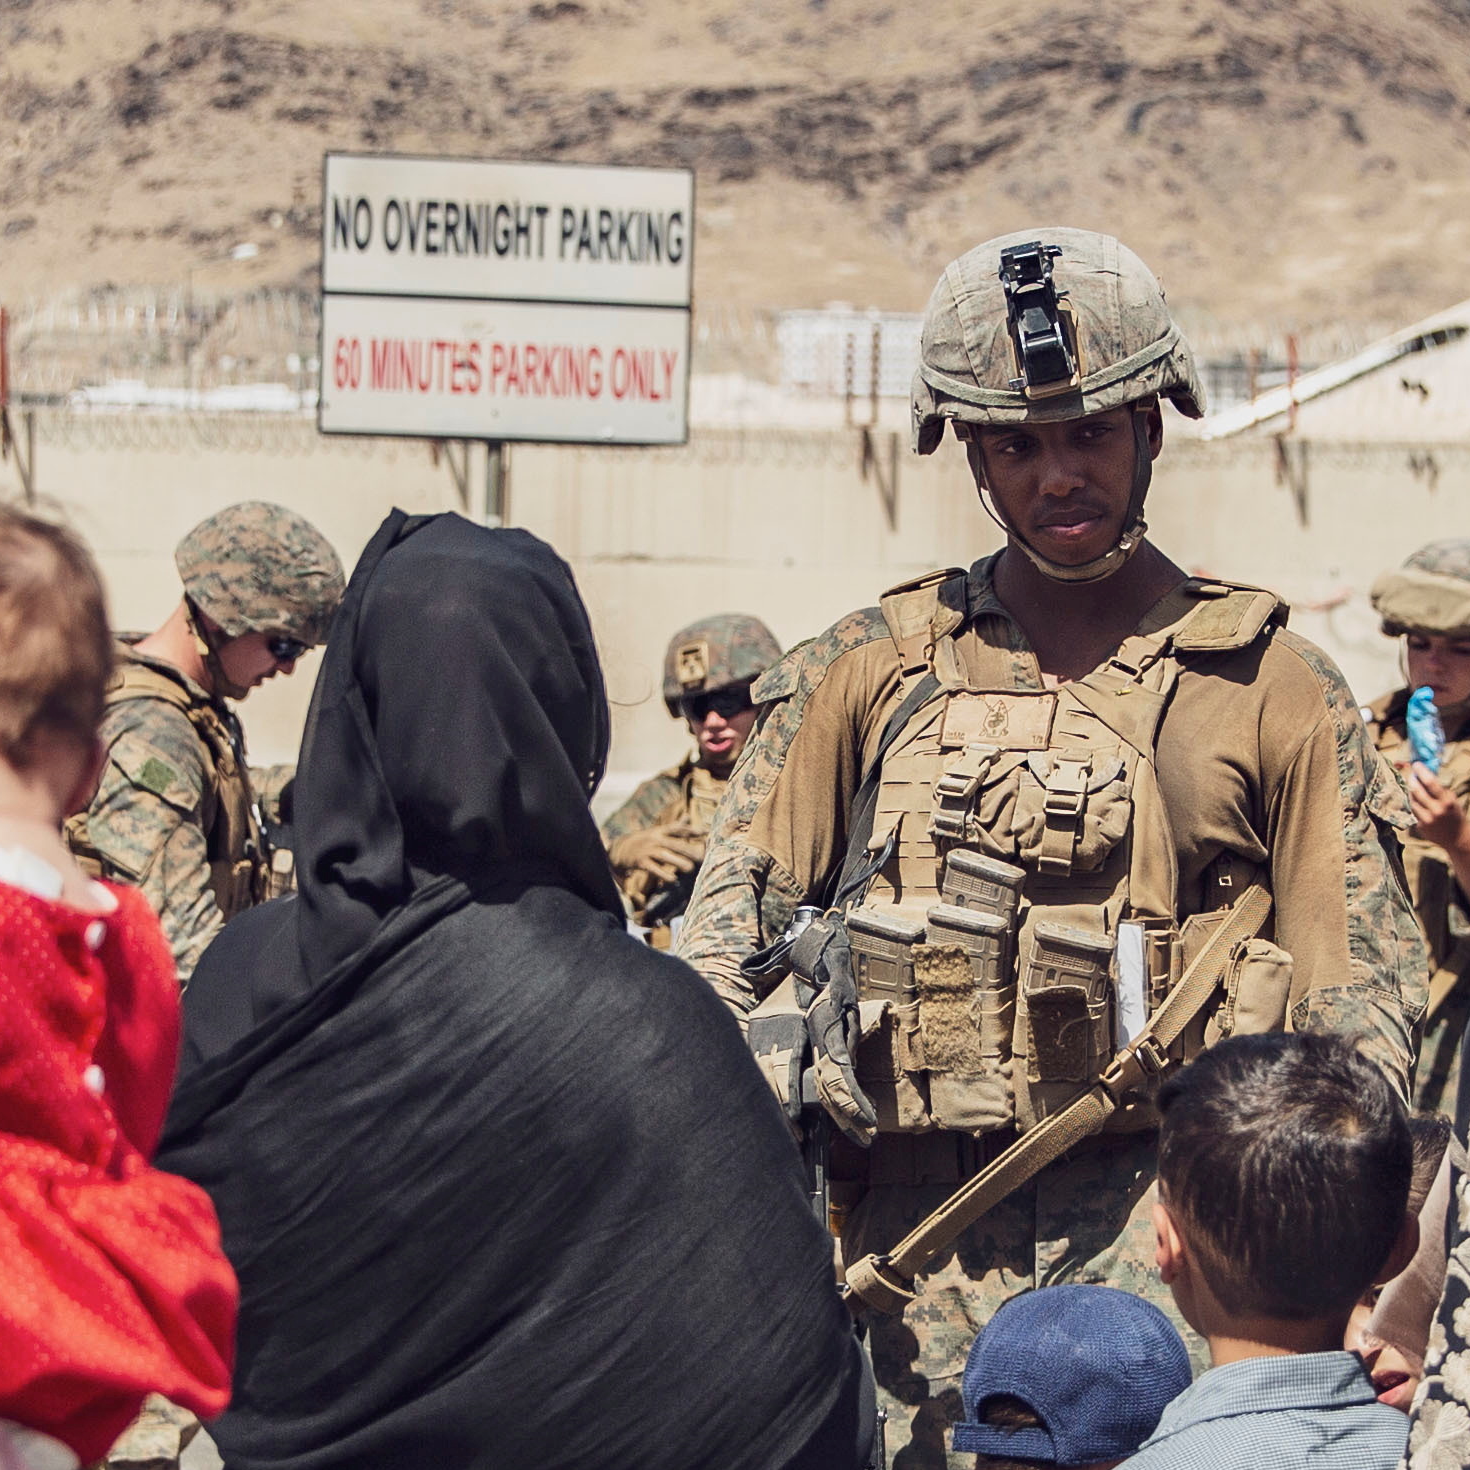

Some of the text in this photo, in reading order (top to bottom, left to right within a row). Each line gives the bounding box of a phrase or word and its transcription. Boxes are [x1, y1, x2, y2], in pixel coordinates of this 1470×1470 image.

[333, 195, 683, 264] NO OVERNIGHT PARKING
[335, 337, 678, 401] 60 MINUTES PARKING ONLY
